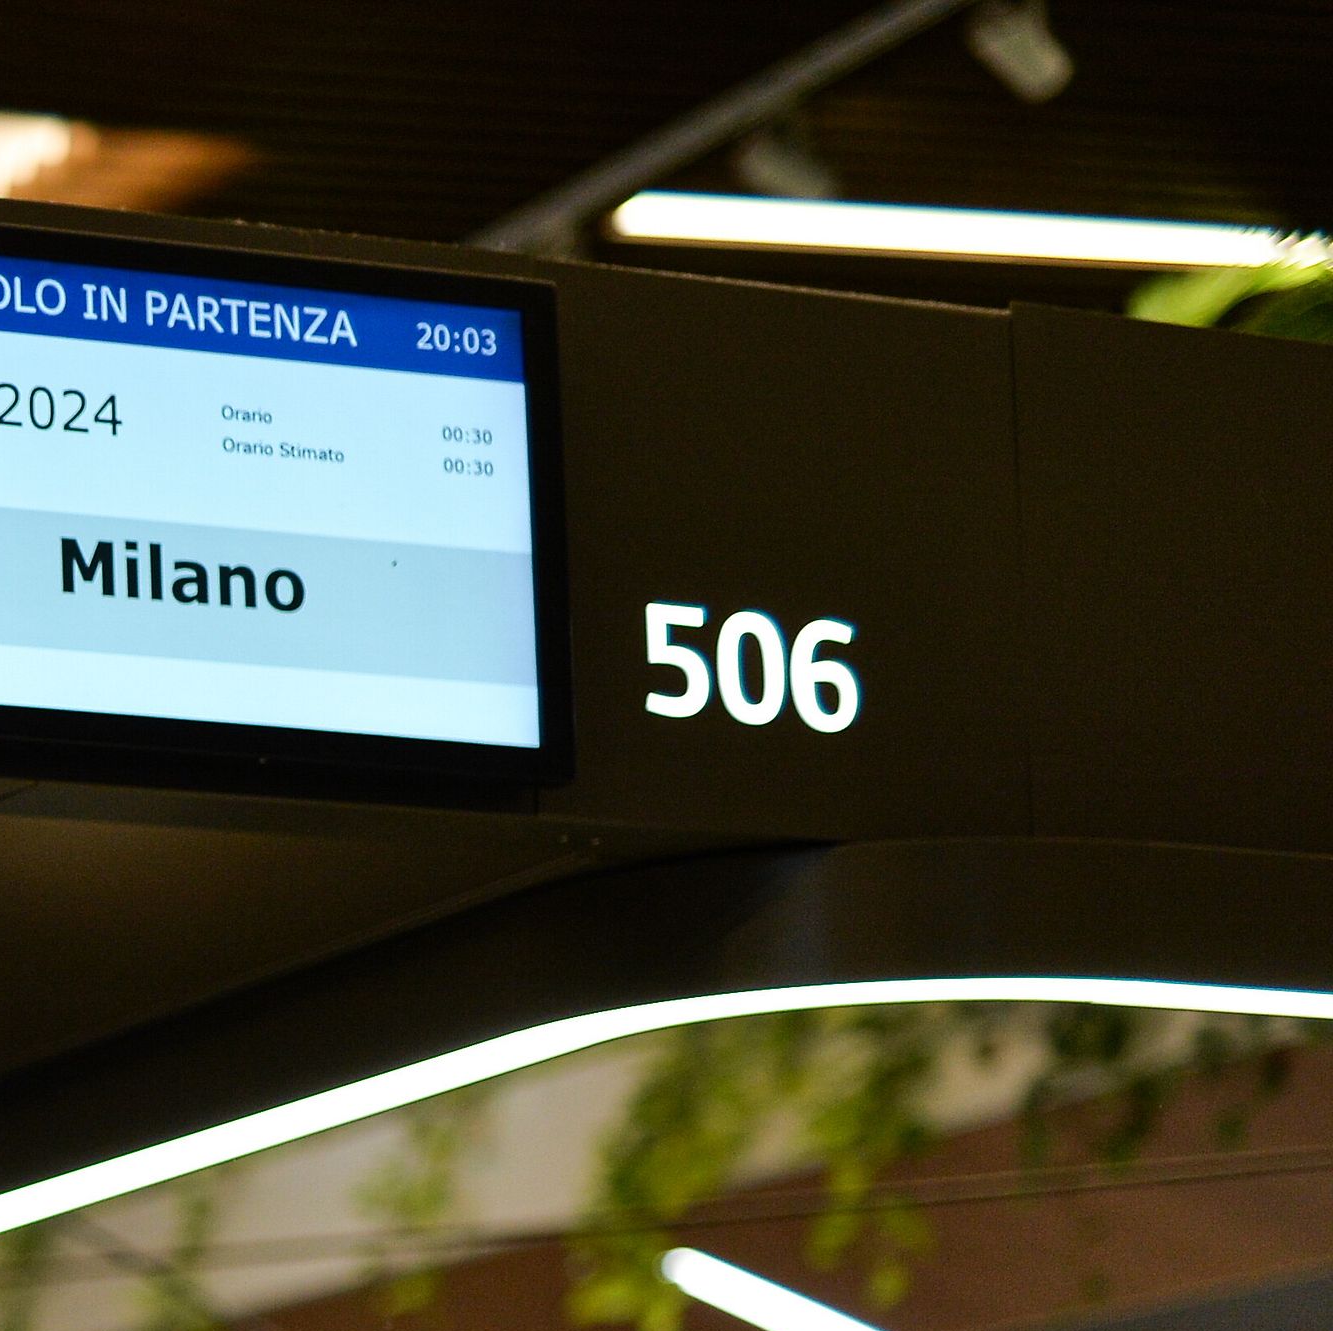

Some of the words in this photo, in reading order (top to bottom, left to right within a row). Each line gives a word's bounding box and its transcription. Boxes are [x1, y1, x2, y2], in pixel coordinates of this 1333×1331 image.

[83, 283, 128, 324] IN
[145, 290, 357, 349] PARTENZA
[415, 321, 498, 357] 20:03
[221, 405, 272, 425] Orario
[222, 437, 274, 456] Orario
[280, 442, 345, 463] Stimato
[442, 426, 493, 445] 00:30
[443, 457, 494, 477] 00:30
[60, 536, 306, 614] Milano
[645, 602, 860, 733] 506
